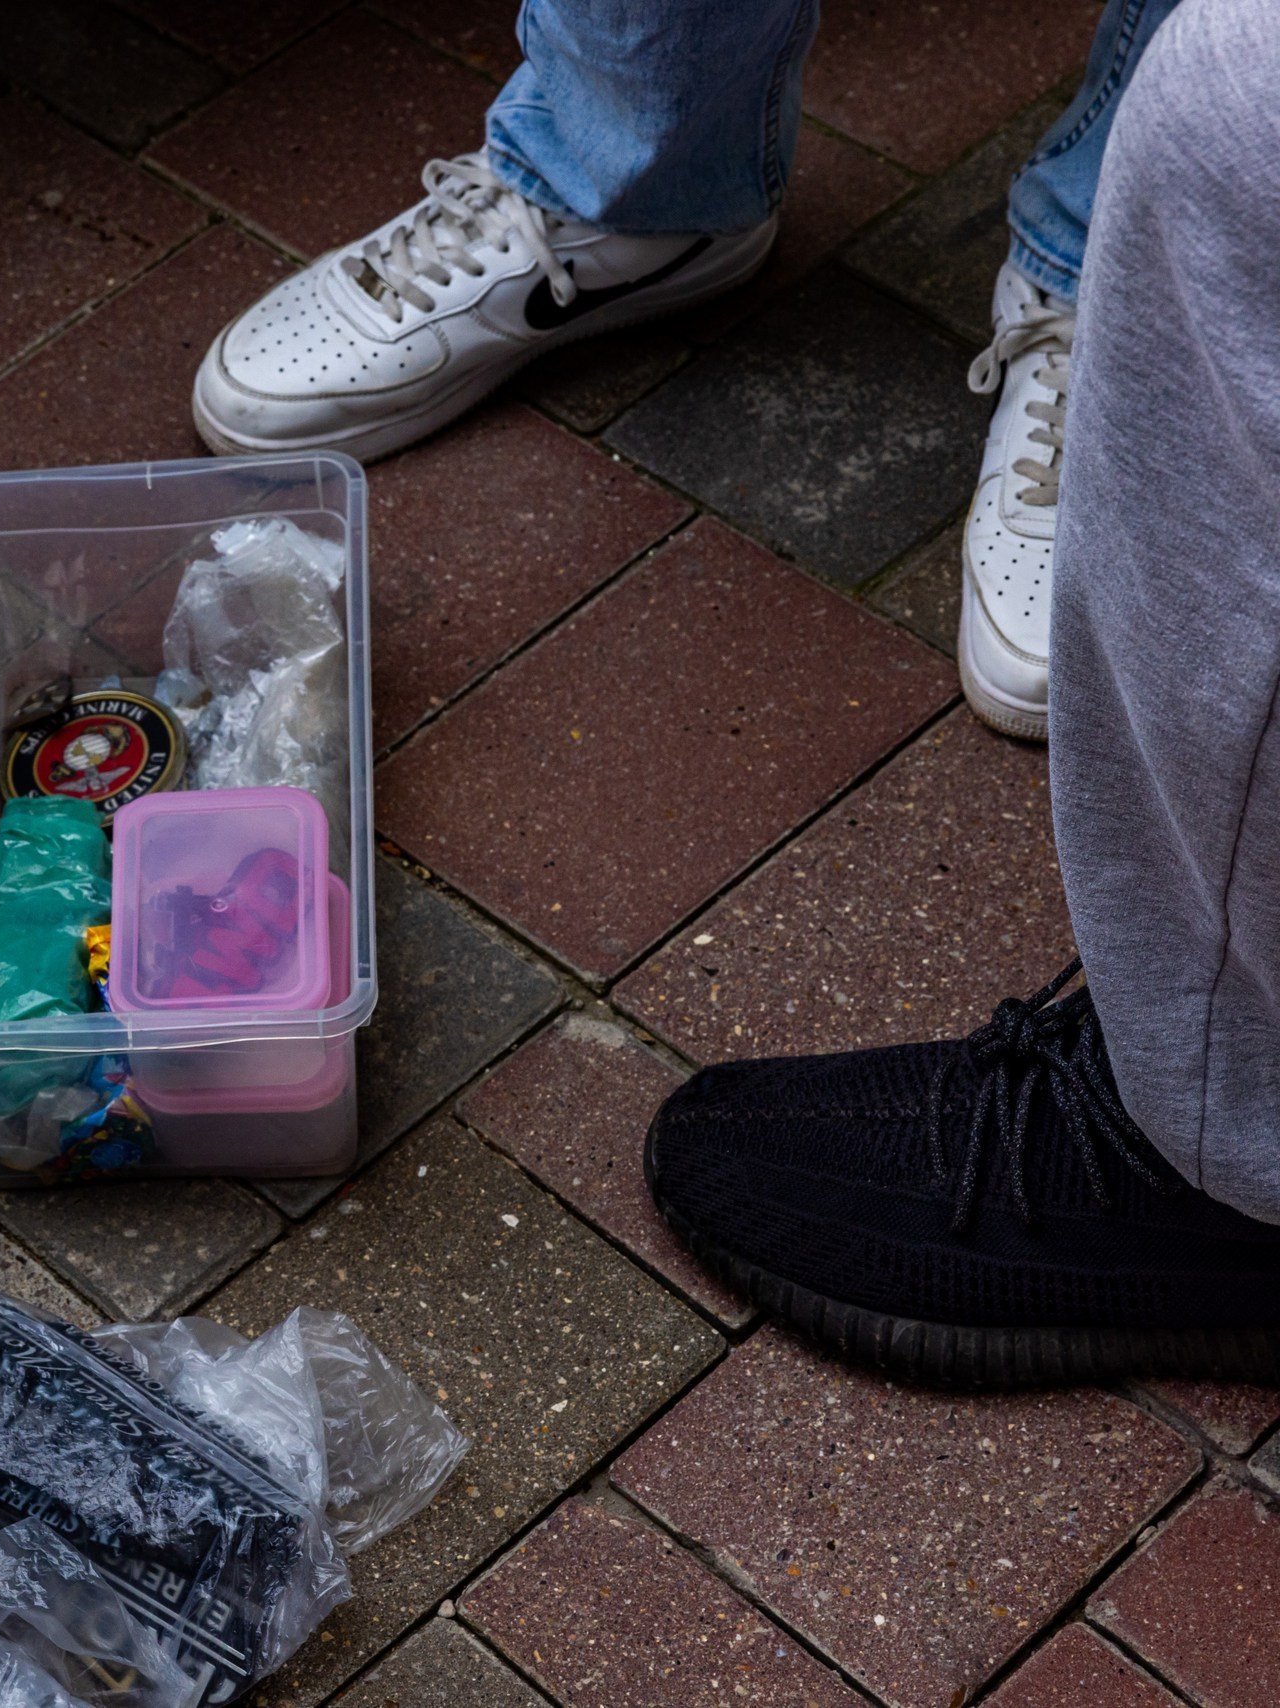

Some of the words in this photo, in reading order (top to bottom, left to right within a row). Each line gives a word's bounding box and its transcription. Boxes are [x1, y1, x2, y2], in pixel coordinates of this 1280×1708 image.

[19, 711, 70, 755] CRPS
[75, 700, 148, 722] MARINE
[103, 751, 167, 812] UNITED
[63, 1378, 167, 1437] Street
